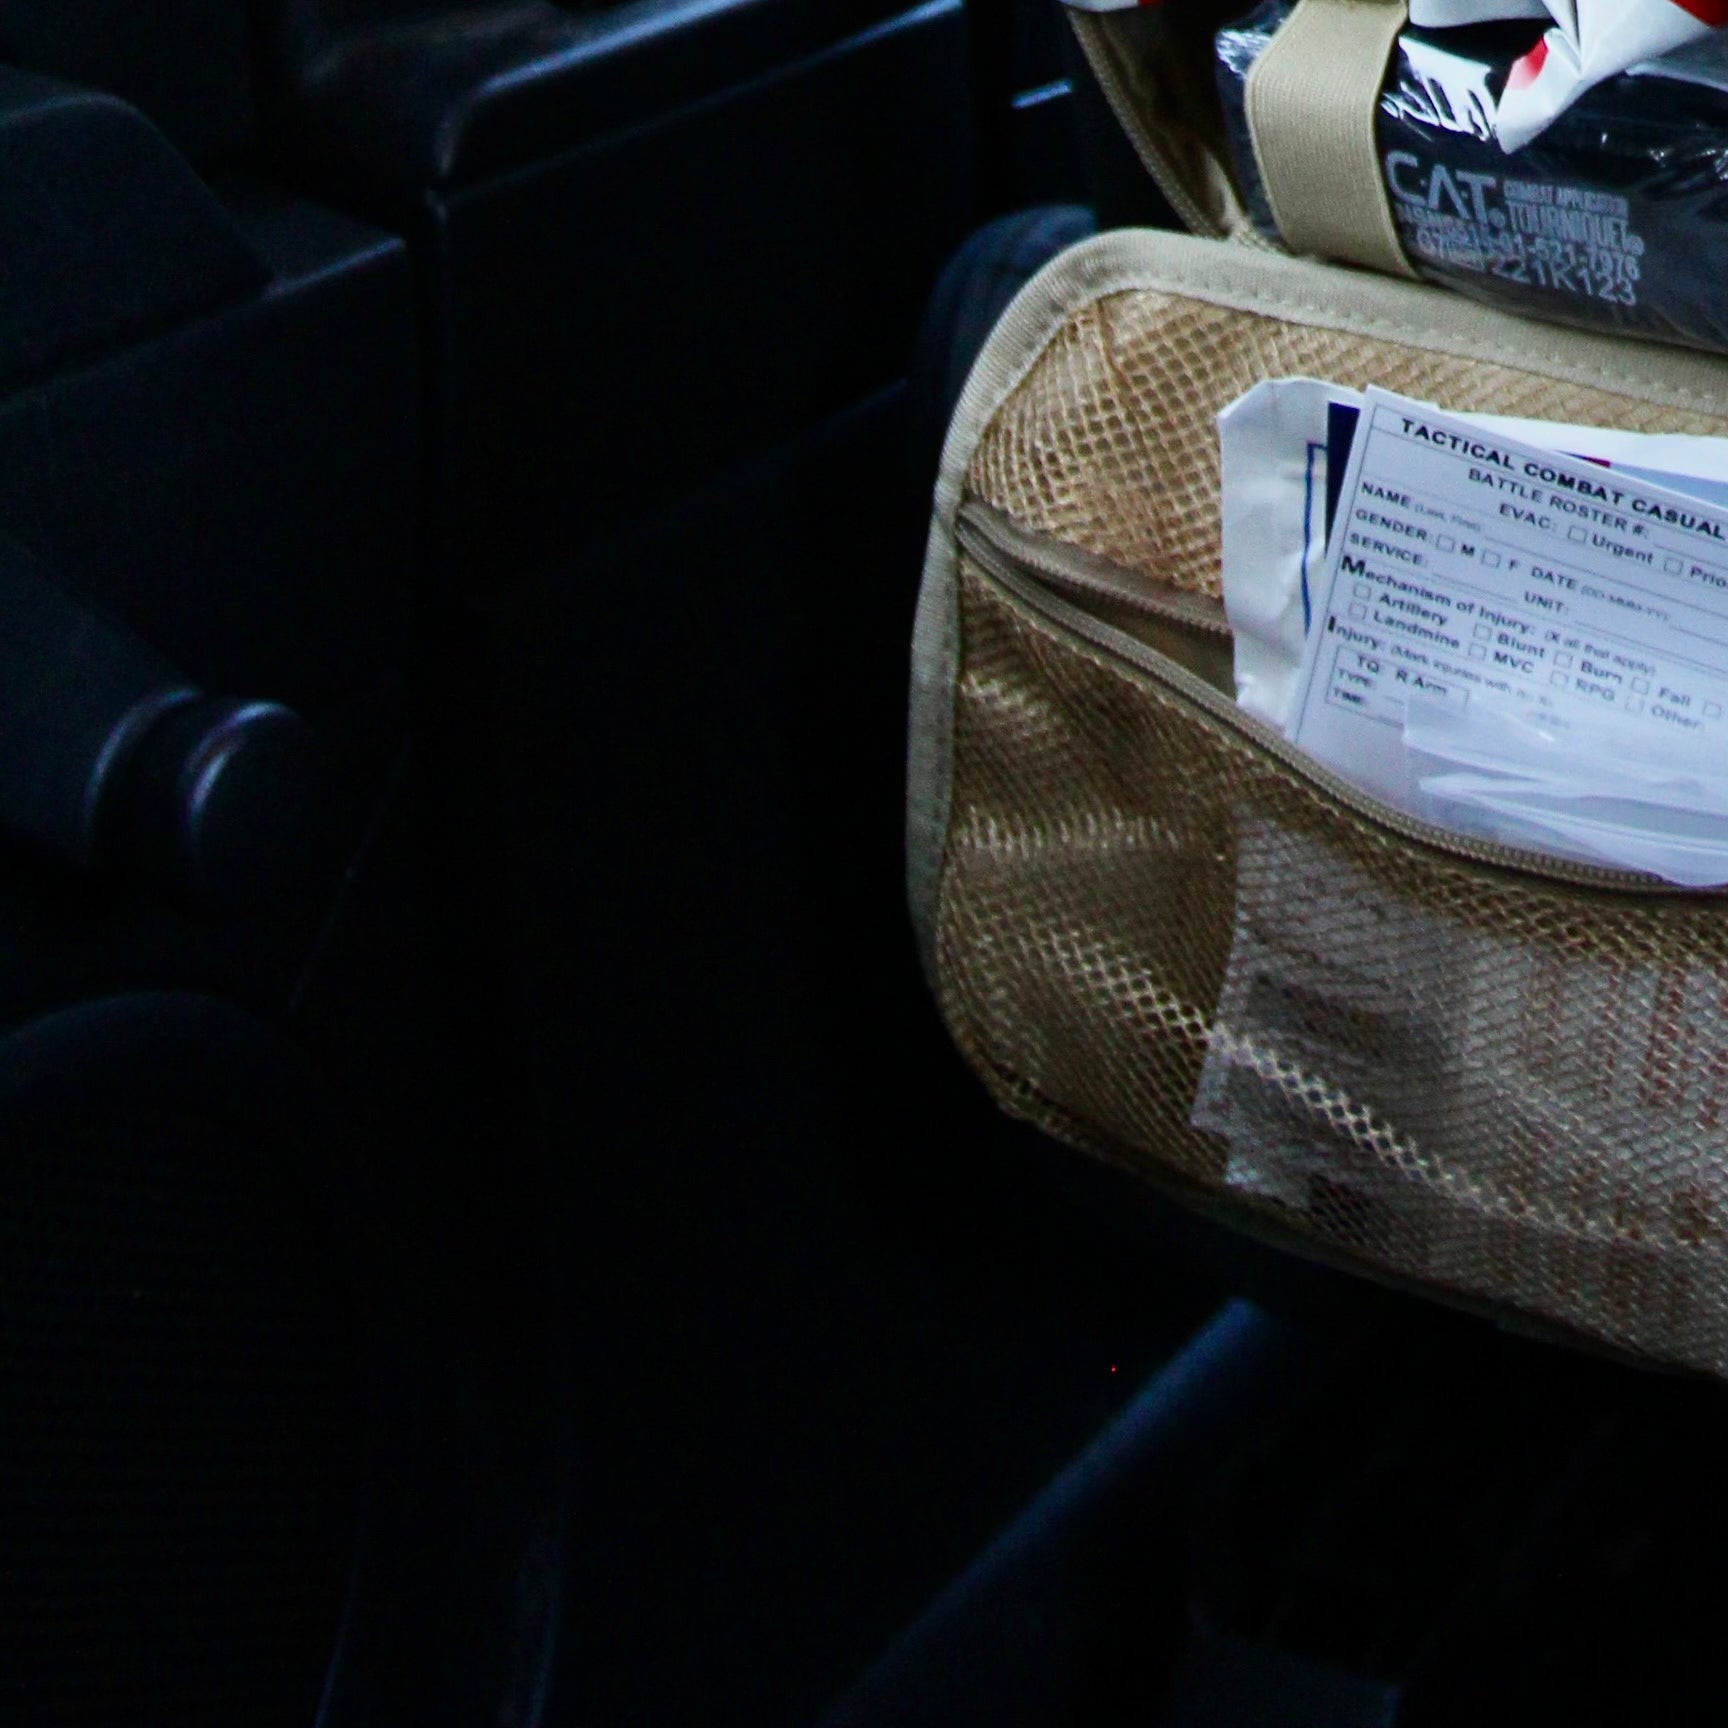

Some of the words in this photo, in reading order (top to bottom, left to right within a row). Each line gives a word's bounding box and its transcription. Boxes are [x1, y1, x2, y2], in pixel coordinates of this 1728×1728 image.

[1402, 417, 1515, 470] TACTICAL
[1524, 462, 1625, 507] COMBAT
[1361, 481, 1411, 509] NAME
[1468, 468, 1544, 503] BATTLE
[1550, 495, 1627, 532] ROSTER
[1461, 544, 1475, 557] M
[1531, 565, 1578, 591] DATE
[1592, 532, 1653, 565] Urgent
[1341, 555, 1451, 607] Mechanism
[1456, 601, 1475, 614] of
[1373, 610, 1460, 649] Landmine
[1494, 650, 1536, 675] MVC
[1379, 593, 1448, 626] Artillery
[1497, 631, 1546, 659] Blunt
[1580, 659, 1623, 685] Burn
[1659, 687, 1692, 708] Fall
[1414, 676, 1448, 695] Arm
